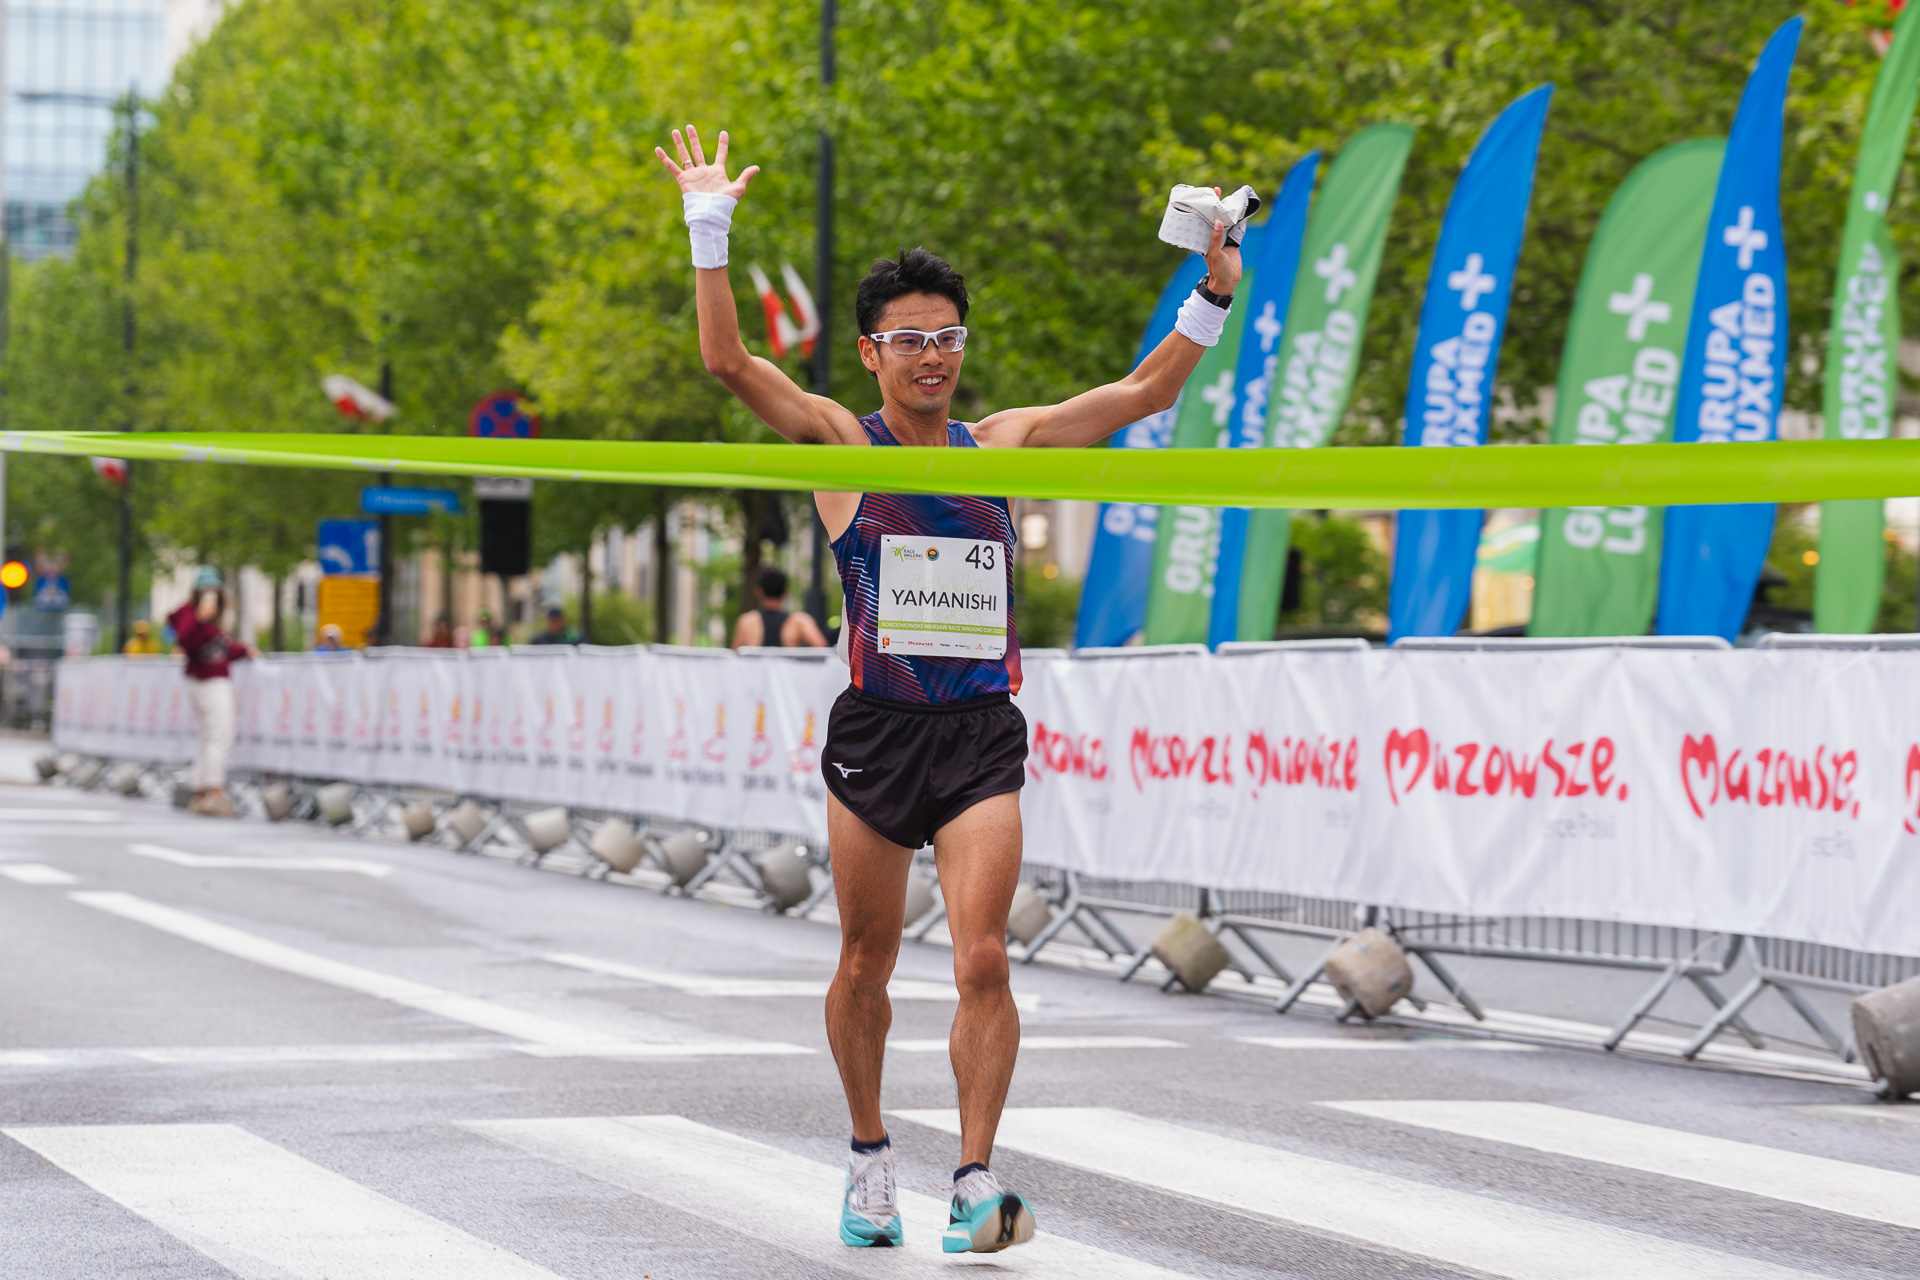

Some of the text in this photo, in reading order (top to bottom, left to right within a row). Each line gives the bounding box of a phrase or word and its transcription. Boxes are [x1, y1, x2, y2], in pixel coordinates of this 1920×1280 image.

[1291, 308, 1357, 448] XMED
[1420, 335, 1462, 447] RUPA
[1450, 311, 1497, 446] XMED
[1733, 272, 1776, 441] UXMED
[1563, 373, 1631, 549] GPA
[891, 588, 997, 612] YAMANISHI
[965, 544, 995, 571] 43
